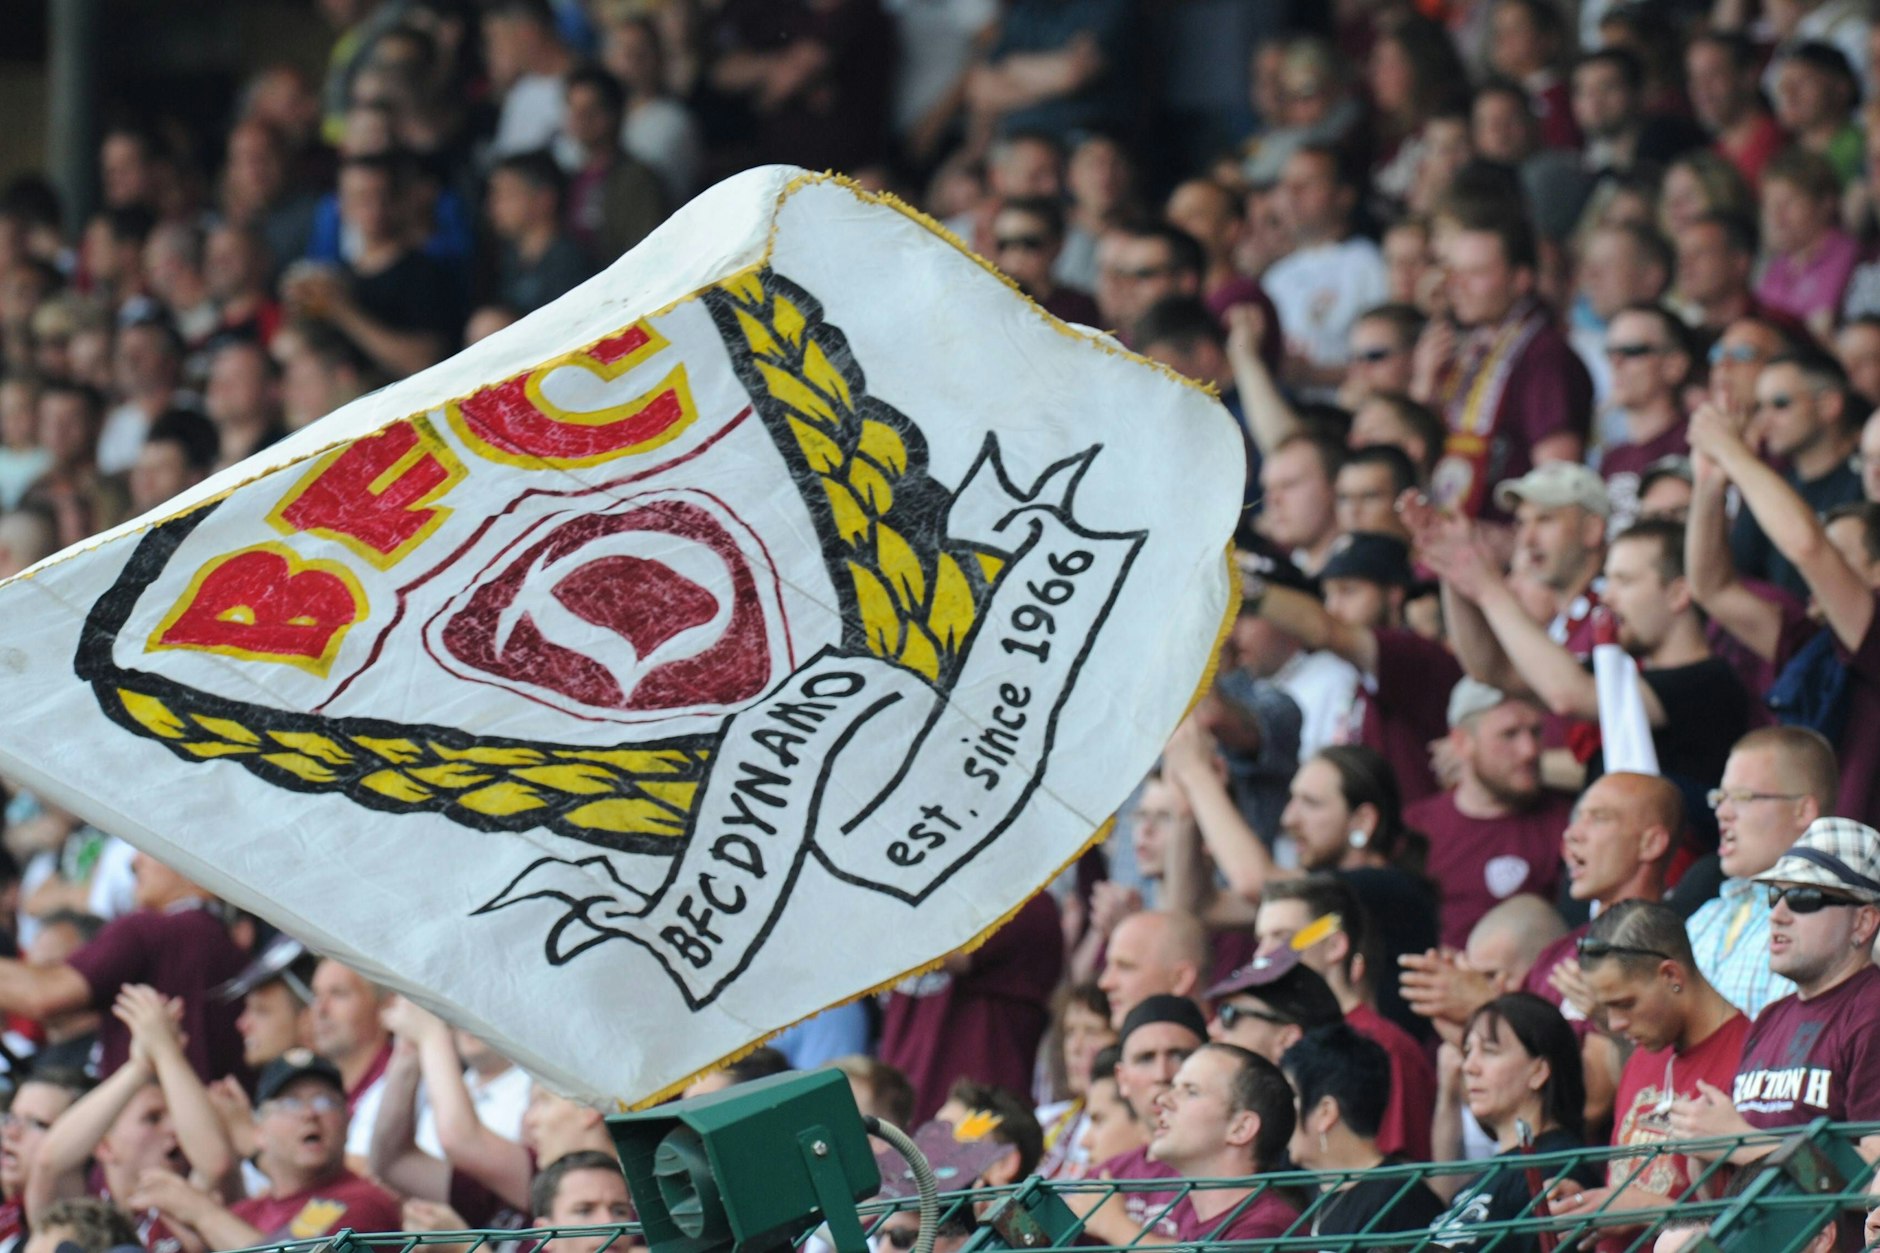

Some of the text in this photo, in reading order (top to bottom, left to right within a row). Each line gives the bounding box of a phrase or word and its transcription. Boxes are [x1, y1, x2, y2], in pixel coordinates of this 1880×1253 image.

[144, 317, 697, 679] BFC
[708, 671, 866, 879] DYNAMO
[886, 549, 1095, 867] est. since 1966
